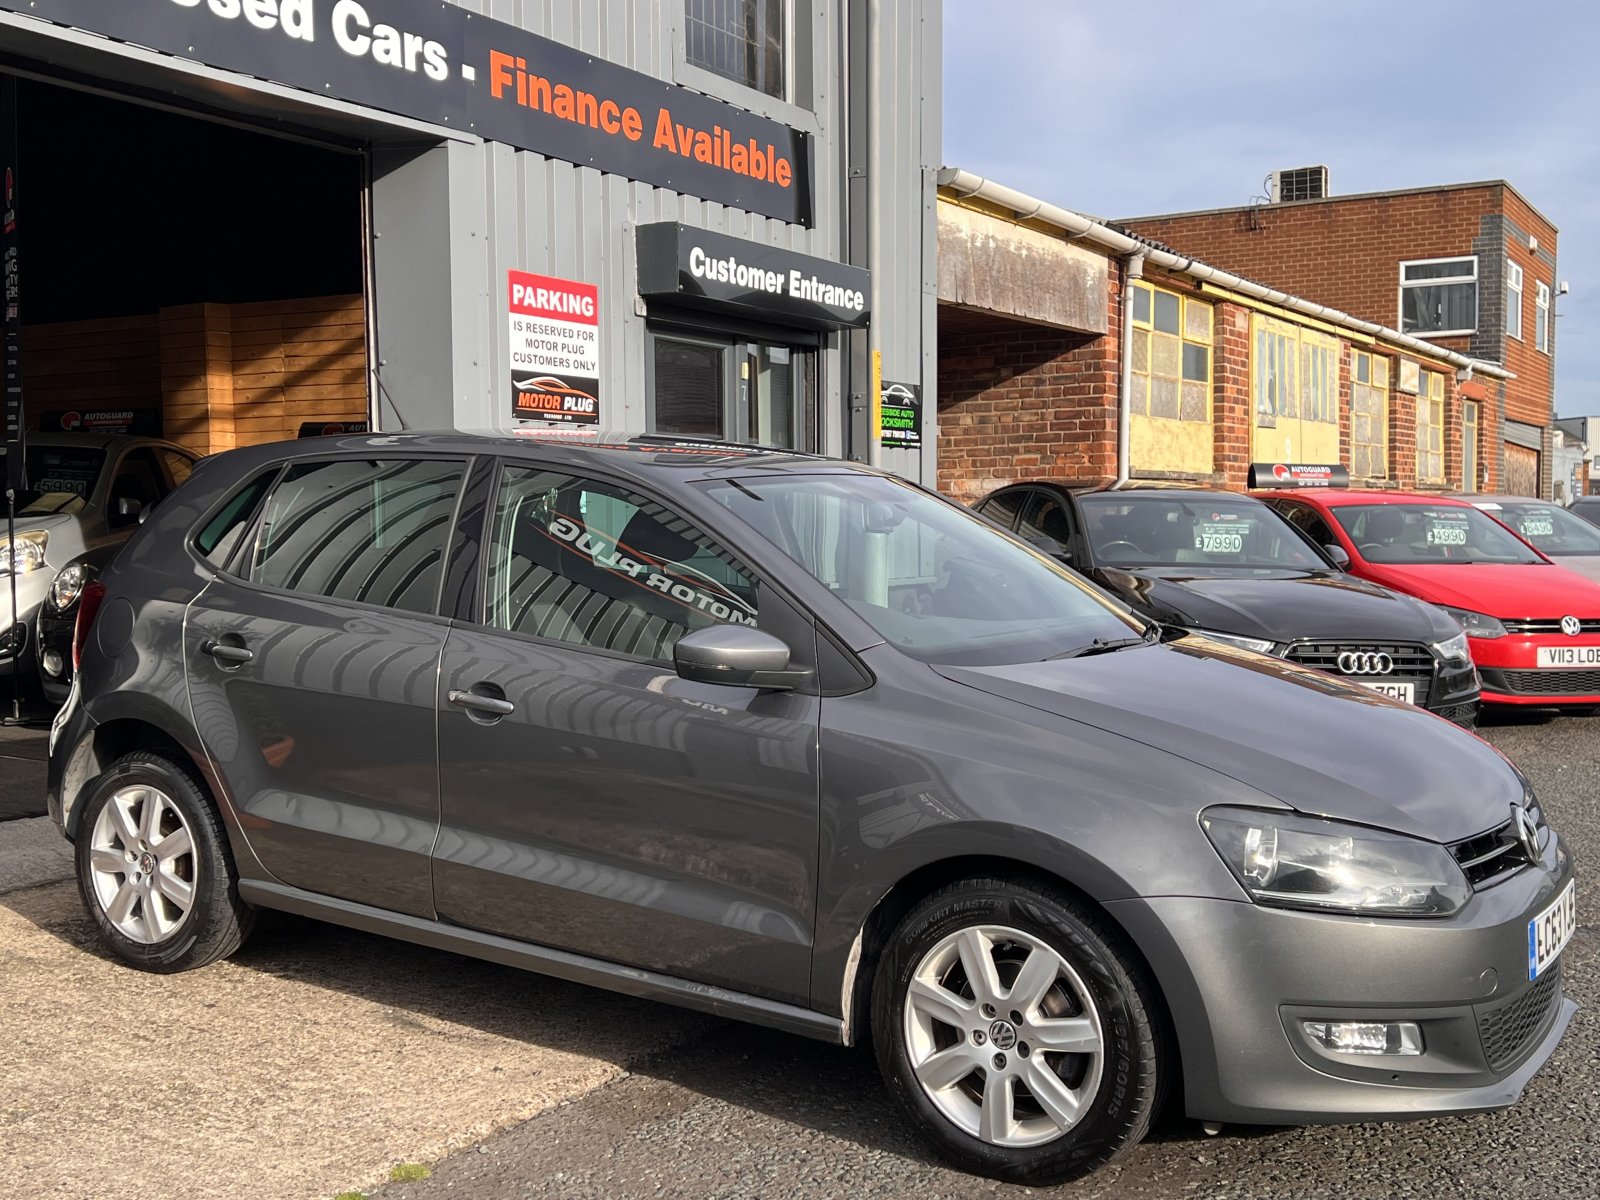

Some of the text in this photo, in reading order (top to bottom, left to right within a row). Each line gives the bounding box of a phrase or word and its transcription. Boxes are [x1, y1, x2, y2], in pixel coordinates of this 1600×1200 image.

[332, 0, 448, 81] Cars
[490, 49, 643, 142] Finance
[653, 108, 792, 188] Available
[689, 246, 864, 311] Customer Entrance
[512, 283, 594, 317] PARKING
[513, 320, 594, 342] IS RESERVED FOR
[525, 338, 585, 355] MOTOR PLUG
[513, 352, 596, 371] CUSTOMERS ONLY
[518, 391, 594, 413] MOTOR PLUG
[84, 411, 134, 420] AUTOGUARD
[901, 410, 915, 418] AUTO
[881, 417, 914, 429] OCKSMITH
[1291, 465, 1331, 474] AUTOGUARD
[33, 480, 85, 496] £5990
[1195, 535, 1241, 550] £7990
[1427, 531, 1465, 542] £4990
[953, 898, 1003, 913] MASTER
[1537, 904, 1562, 965] LC63
